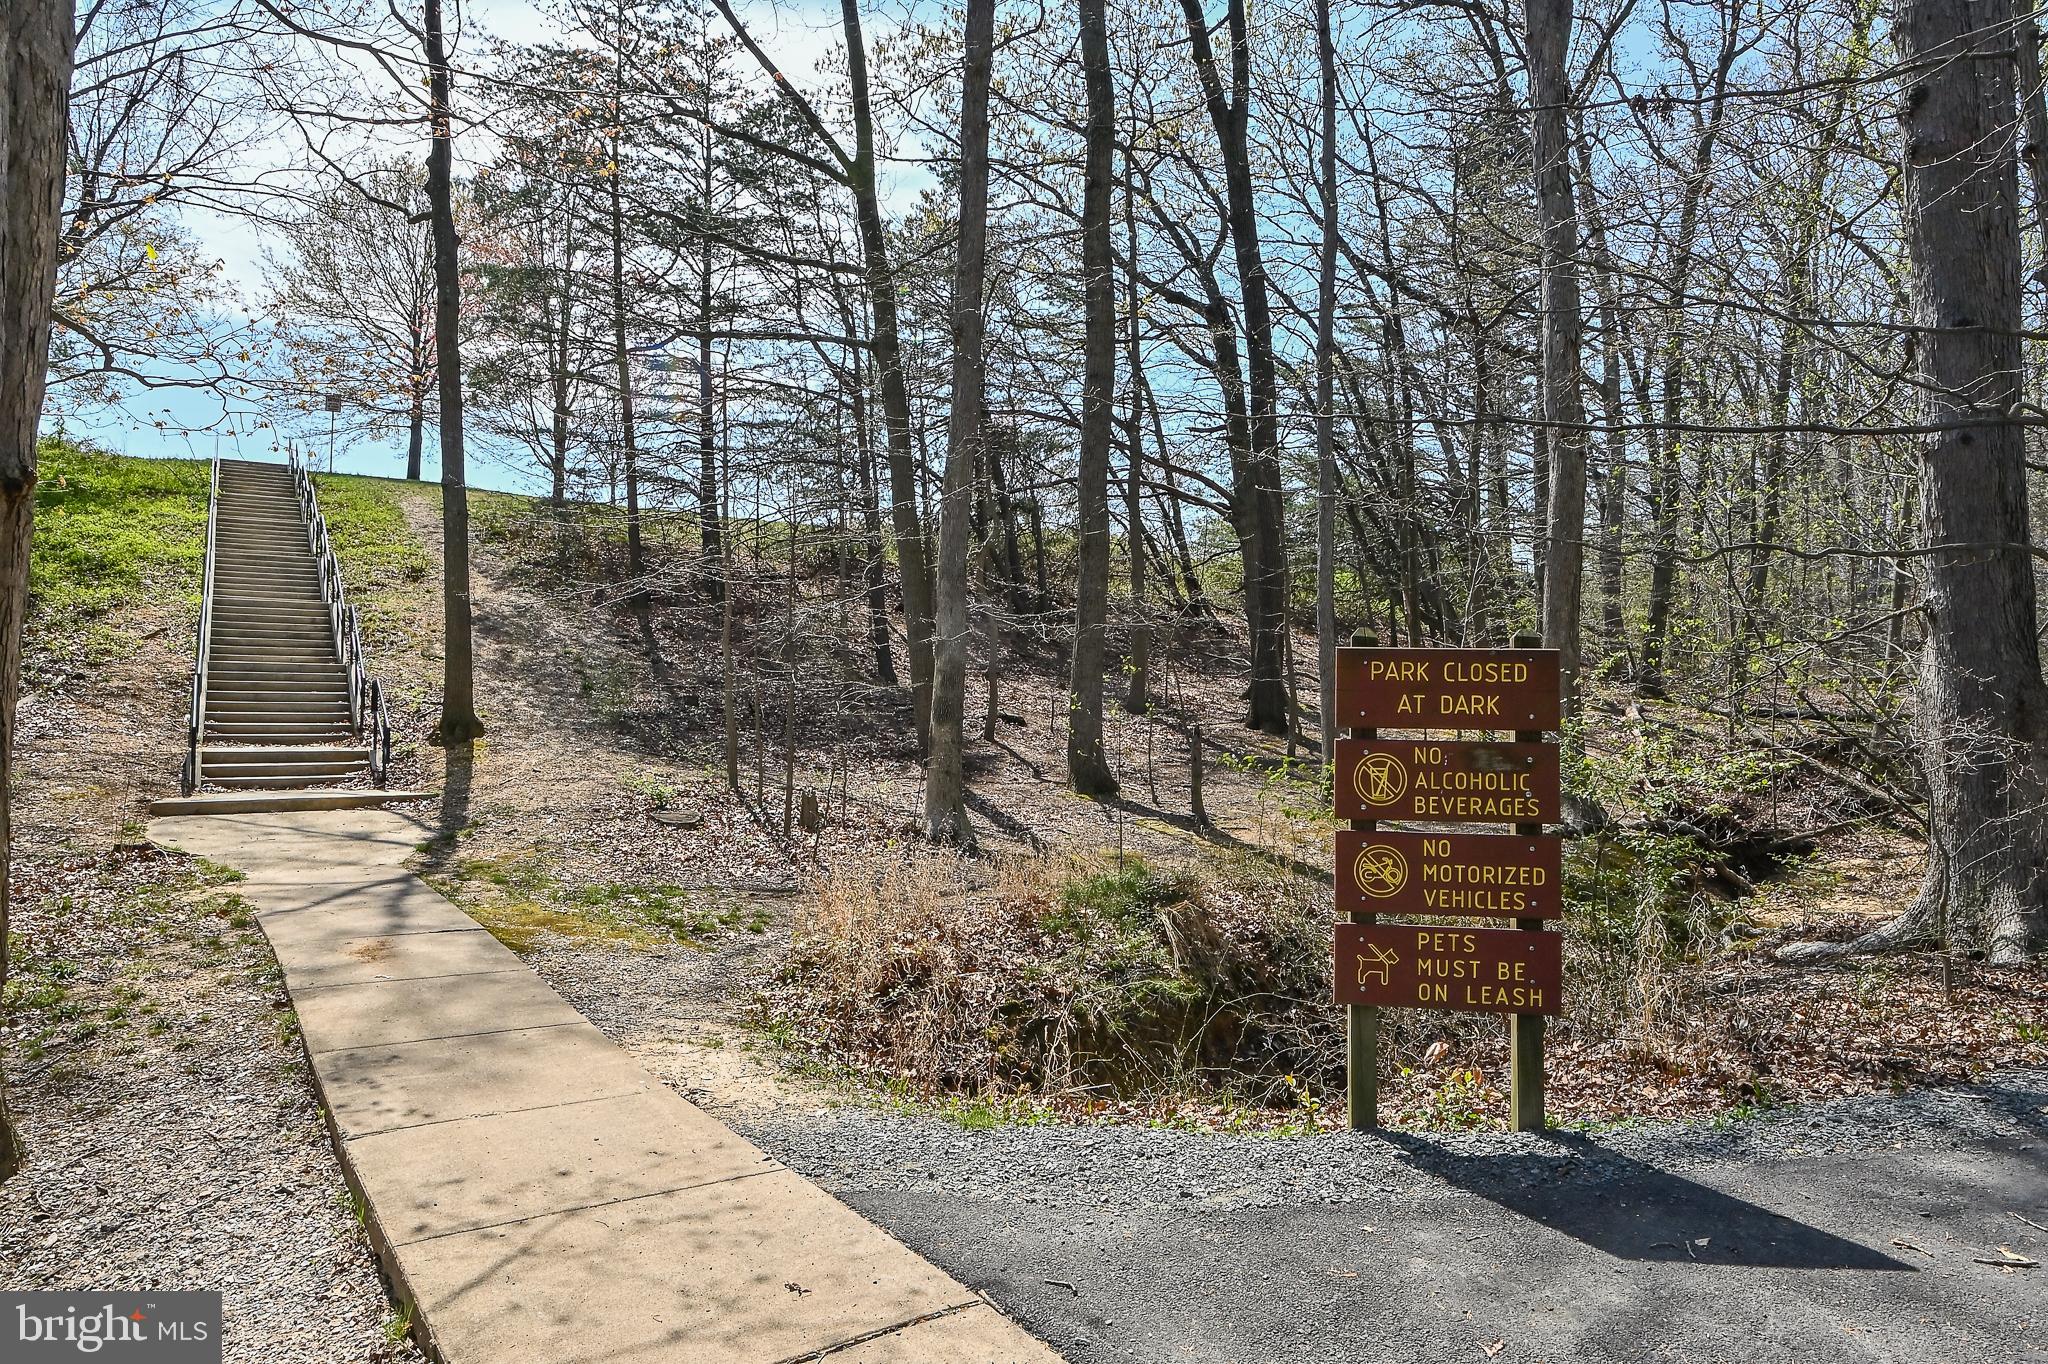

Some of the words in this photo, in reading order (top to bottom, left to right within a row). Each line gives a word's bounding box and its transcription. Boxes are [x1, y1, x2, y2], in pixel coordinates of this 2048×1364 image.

[1370, 661, 1430, 681] PARK
[1443, 662, 1528, 683] CLOSED
[1397, 694, 1426, 714] AT
[1440, 695, 1501, 715] DARK
[1414, 747, 1442, 765] NO
[1415, 771, 1531, 791] ALCOHOLIC
[1414, 797, 1540, 817] BEVERAGES
[1423, 839, 1451, 857] NO
[1423, 864, 1546, 886] MOTORIZED
[1423, 889, 1526, 910] VEHICLES
[1417, 933, 1476, 953] PETS
[1417, 958, 1481, 979] MUST
[1498, 962, 1525, 981] BE
[1418, 983, 1448, 1002] ON
[1467, 985, 1543, 1007] LEASH
